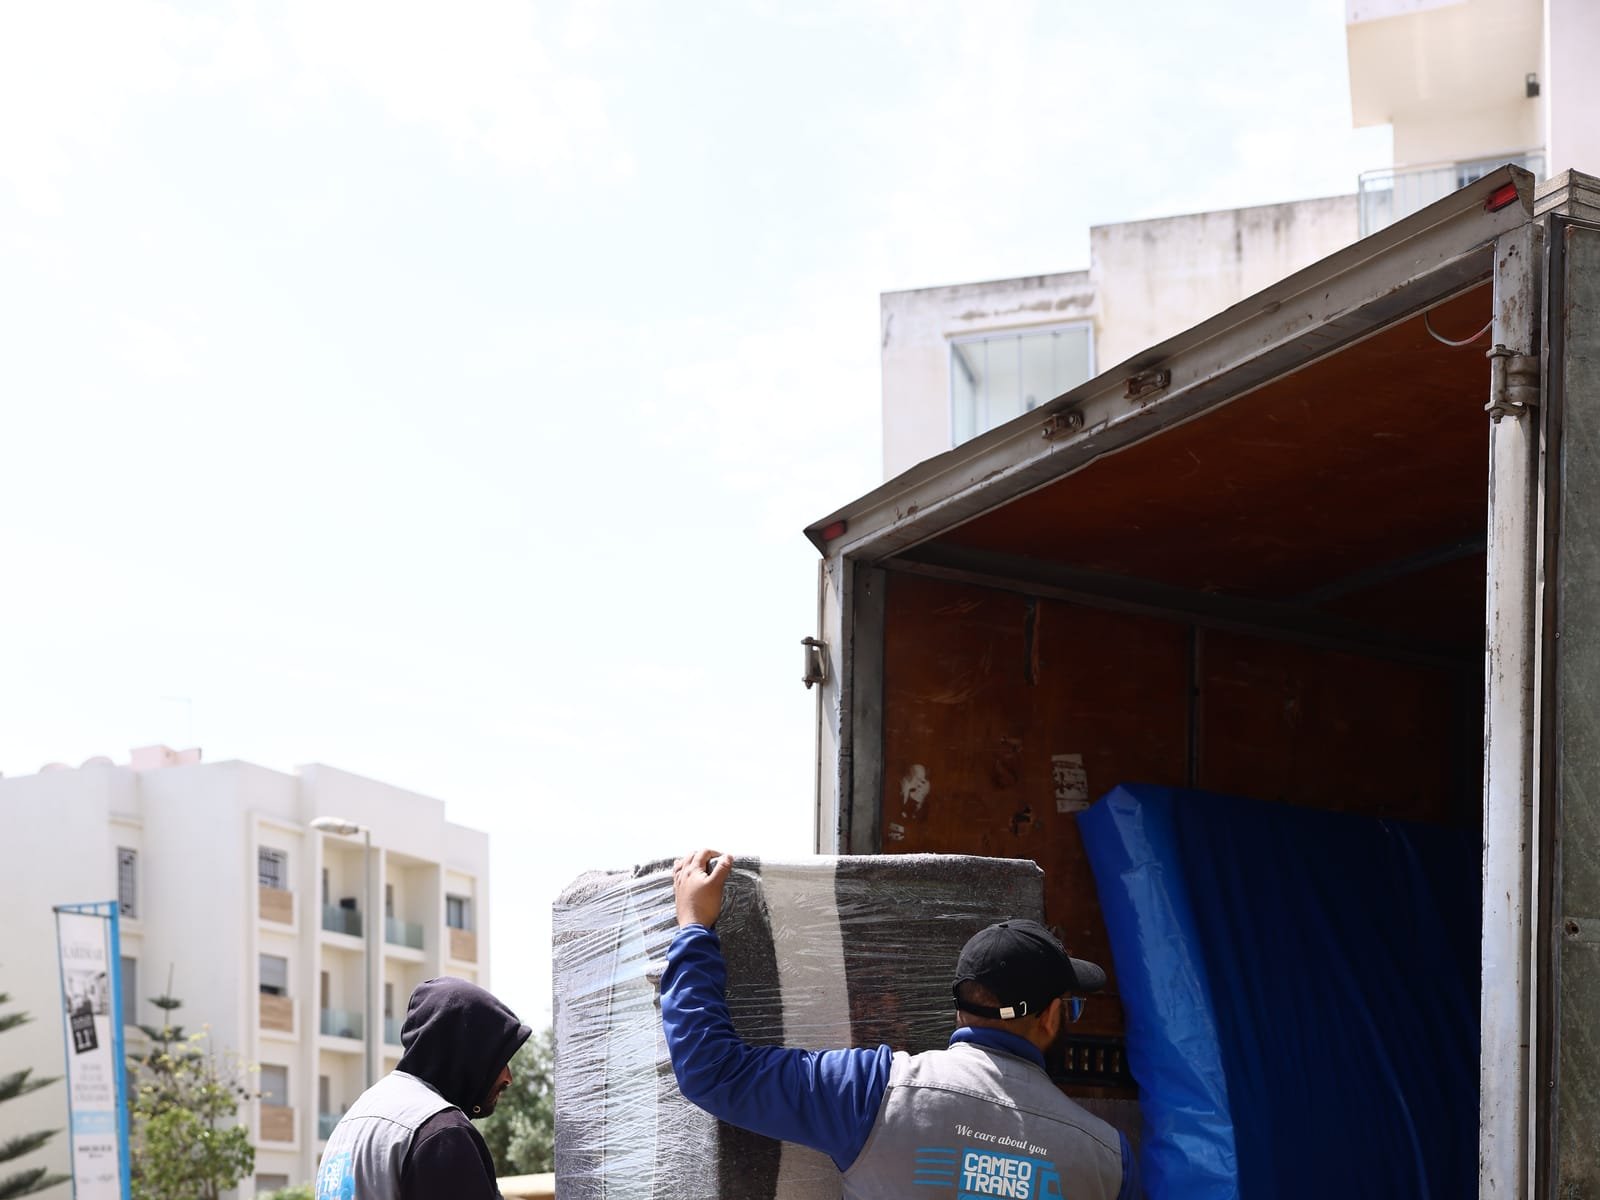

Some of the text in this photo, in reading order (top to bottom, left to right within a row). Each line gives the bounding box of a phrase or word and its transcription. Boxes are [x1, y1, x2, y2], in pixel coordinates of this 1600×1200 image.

[955, 1124, 1048, 1156] We care about you
[964, 1153, 1032, 1181] CAMEO
[963, 1171, 1030, 1200] TRANS
